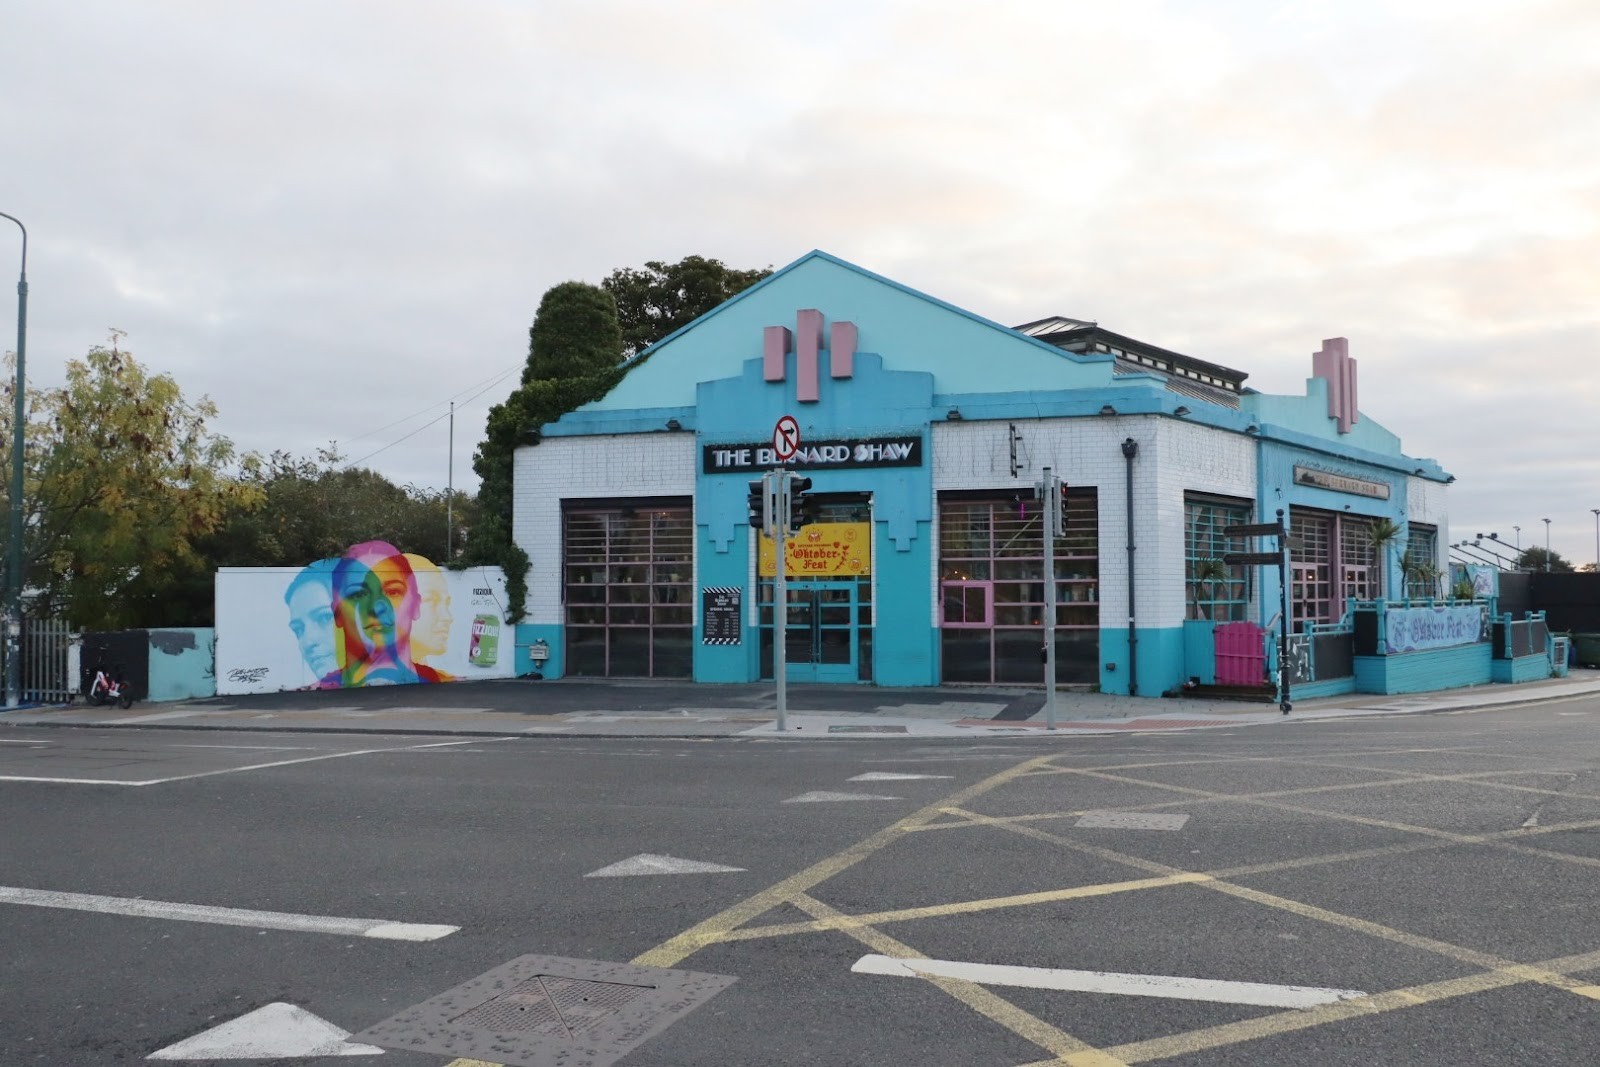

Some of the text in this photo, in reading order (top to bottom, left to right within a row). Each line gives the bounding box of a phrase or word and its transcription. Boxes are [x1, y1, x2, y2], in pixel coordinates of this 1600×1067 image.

[712, 449, 751, 467] THE
[853, 442, 913, 462] SHAW
[793, 547, 837, 559] Oktober
[803, 559, 828, 569] Fest
